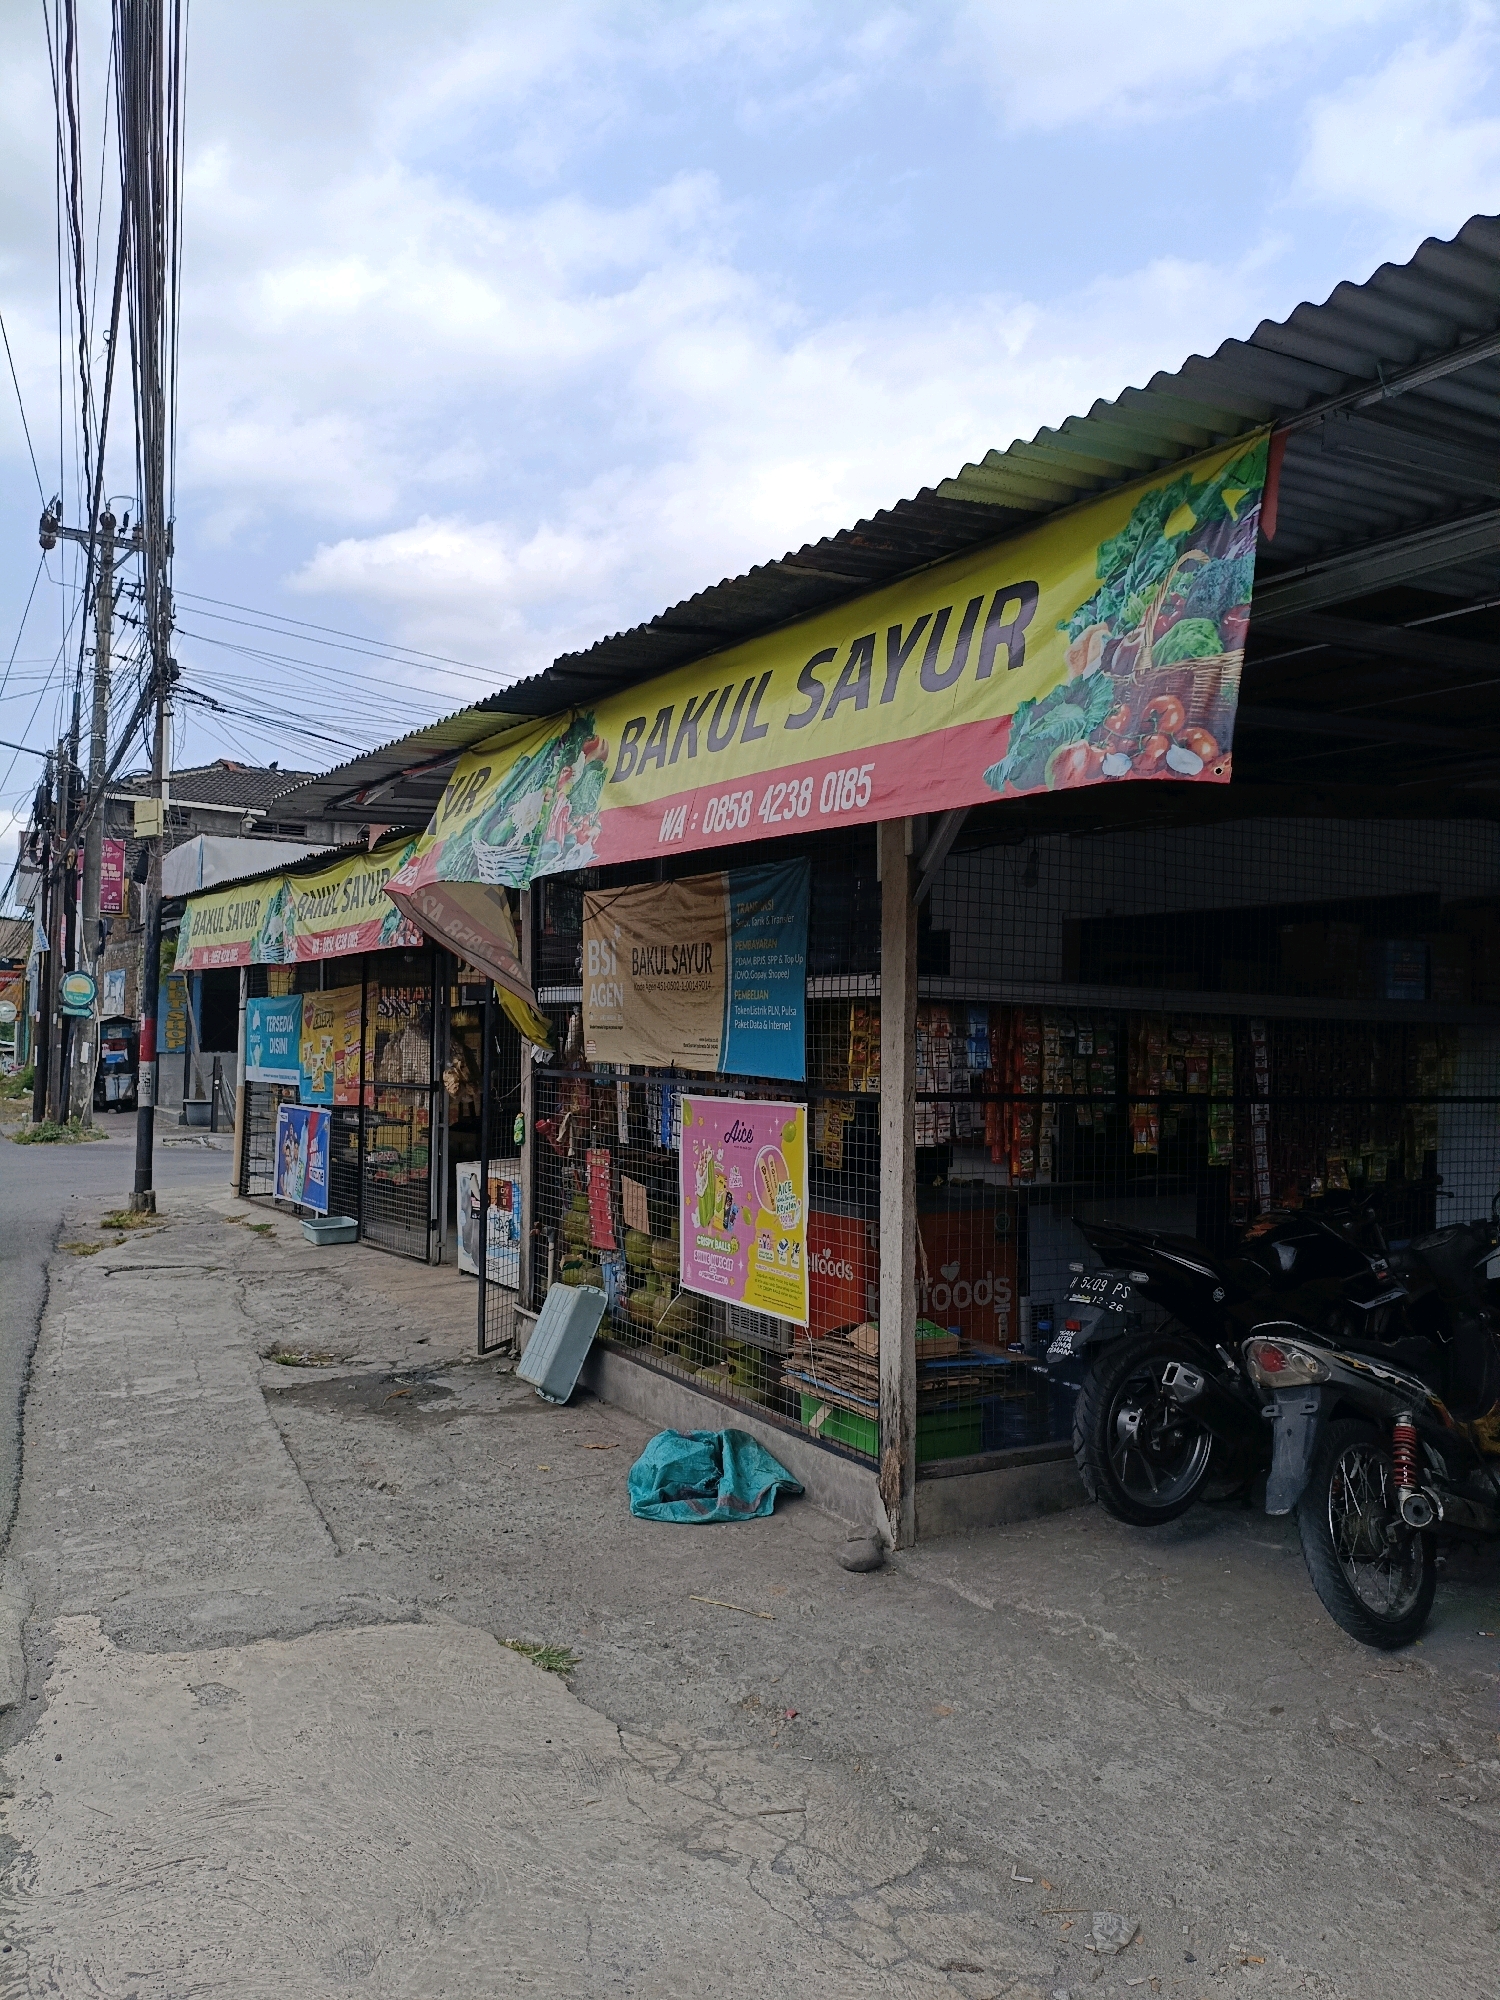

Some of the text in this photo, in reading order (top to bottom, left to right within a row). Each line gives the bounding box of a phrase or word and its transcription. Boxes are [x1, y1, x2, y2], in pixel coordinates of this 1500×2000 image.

[609, 580, 1039, 784] BAKUL SAYUR
[658, 804, 686, 842] WA
[702, 790, 753, 835] 0858
[757, 777, 814, 824] 4238
[820, 763, 876, 813] 0185
[297, 868, 390, 921] BAKUL SAYUR
[192, 899, 261, 936] BAKUL SAYUR
[734, 938, 778, 951] PEMBAYARAN
[632, 942, 713, 976] BAKUL SAYUR
[794, 953, 804, 966] Up
[588, 982, 624, 1008] AGEN
[734, 989, 769, 1000] PEMBELIAN
[781, 1005, 797, 1016] Pulsa
[165, 1010, 187, 1049] SHOP
[266, 1015, 294, 1033] TERSEDIA
[734, 1020, 749, 1029] Paket
[749, 1020, 763, 1030] Data
[768, 1020, 792, 1031] Internet
[269, 1037, 288, 1055] DISINI
[724, 1119, 754, 1144] Aice
[778, 1182, 792, 1196] AICE
[1111, 1282, 1131, 1299] PS
